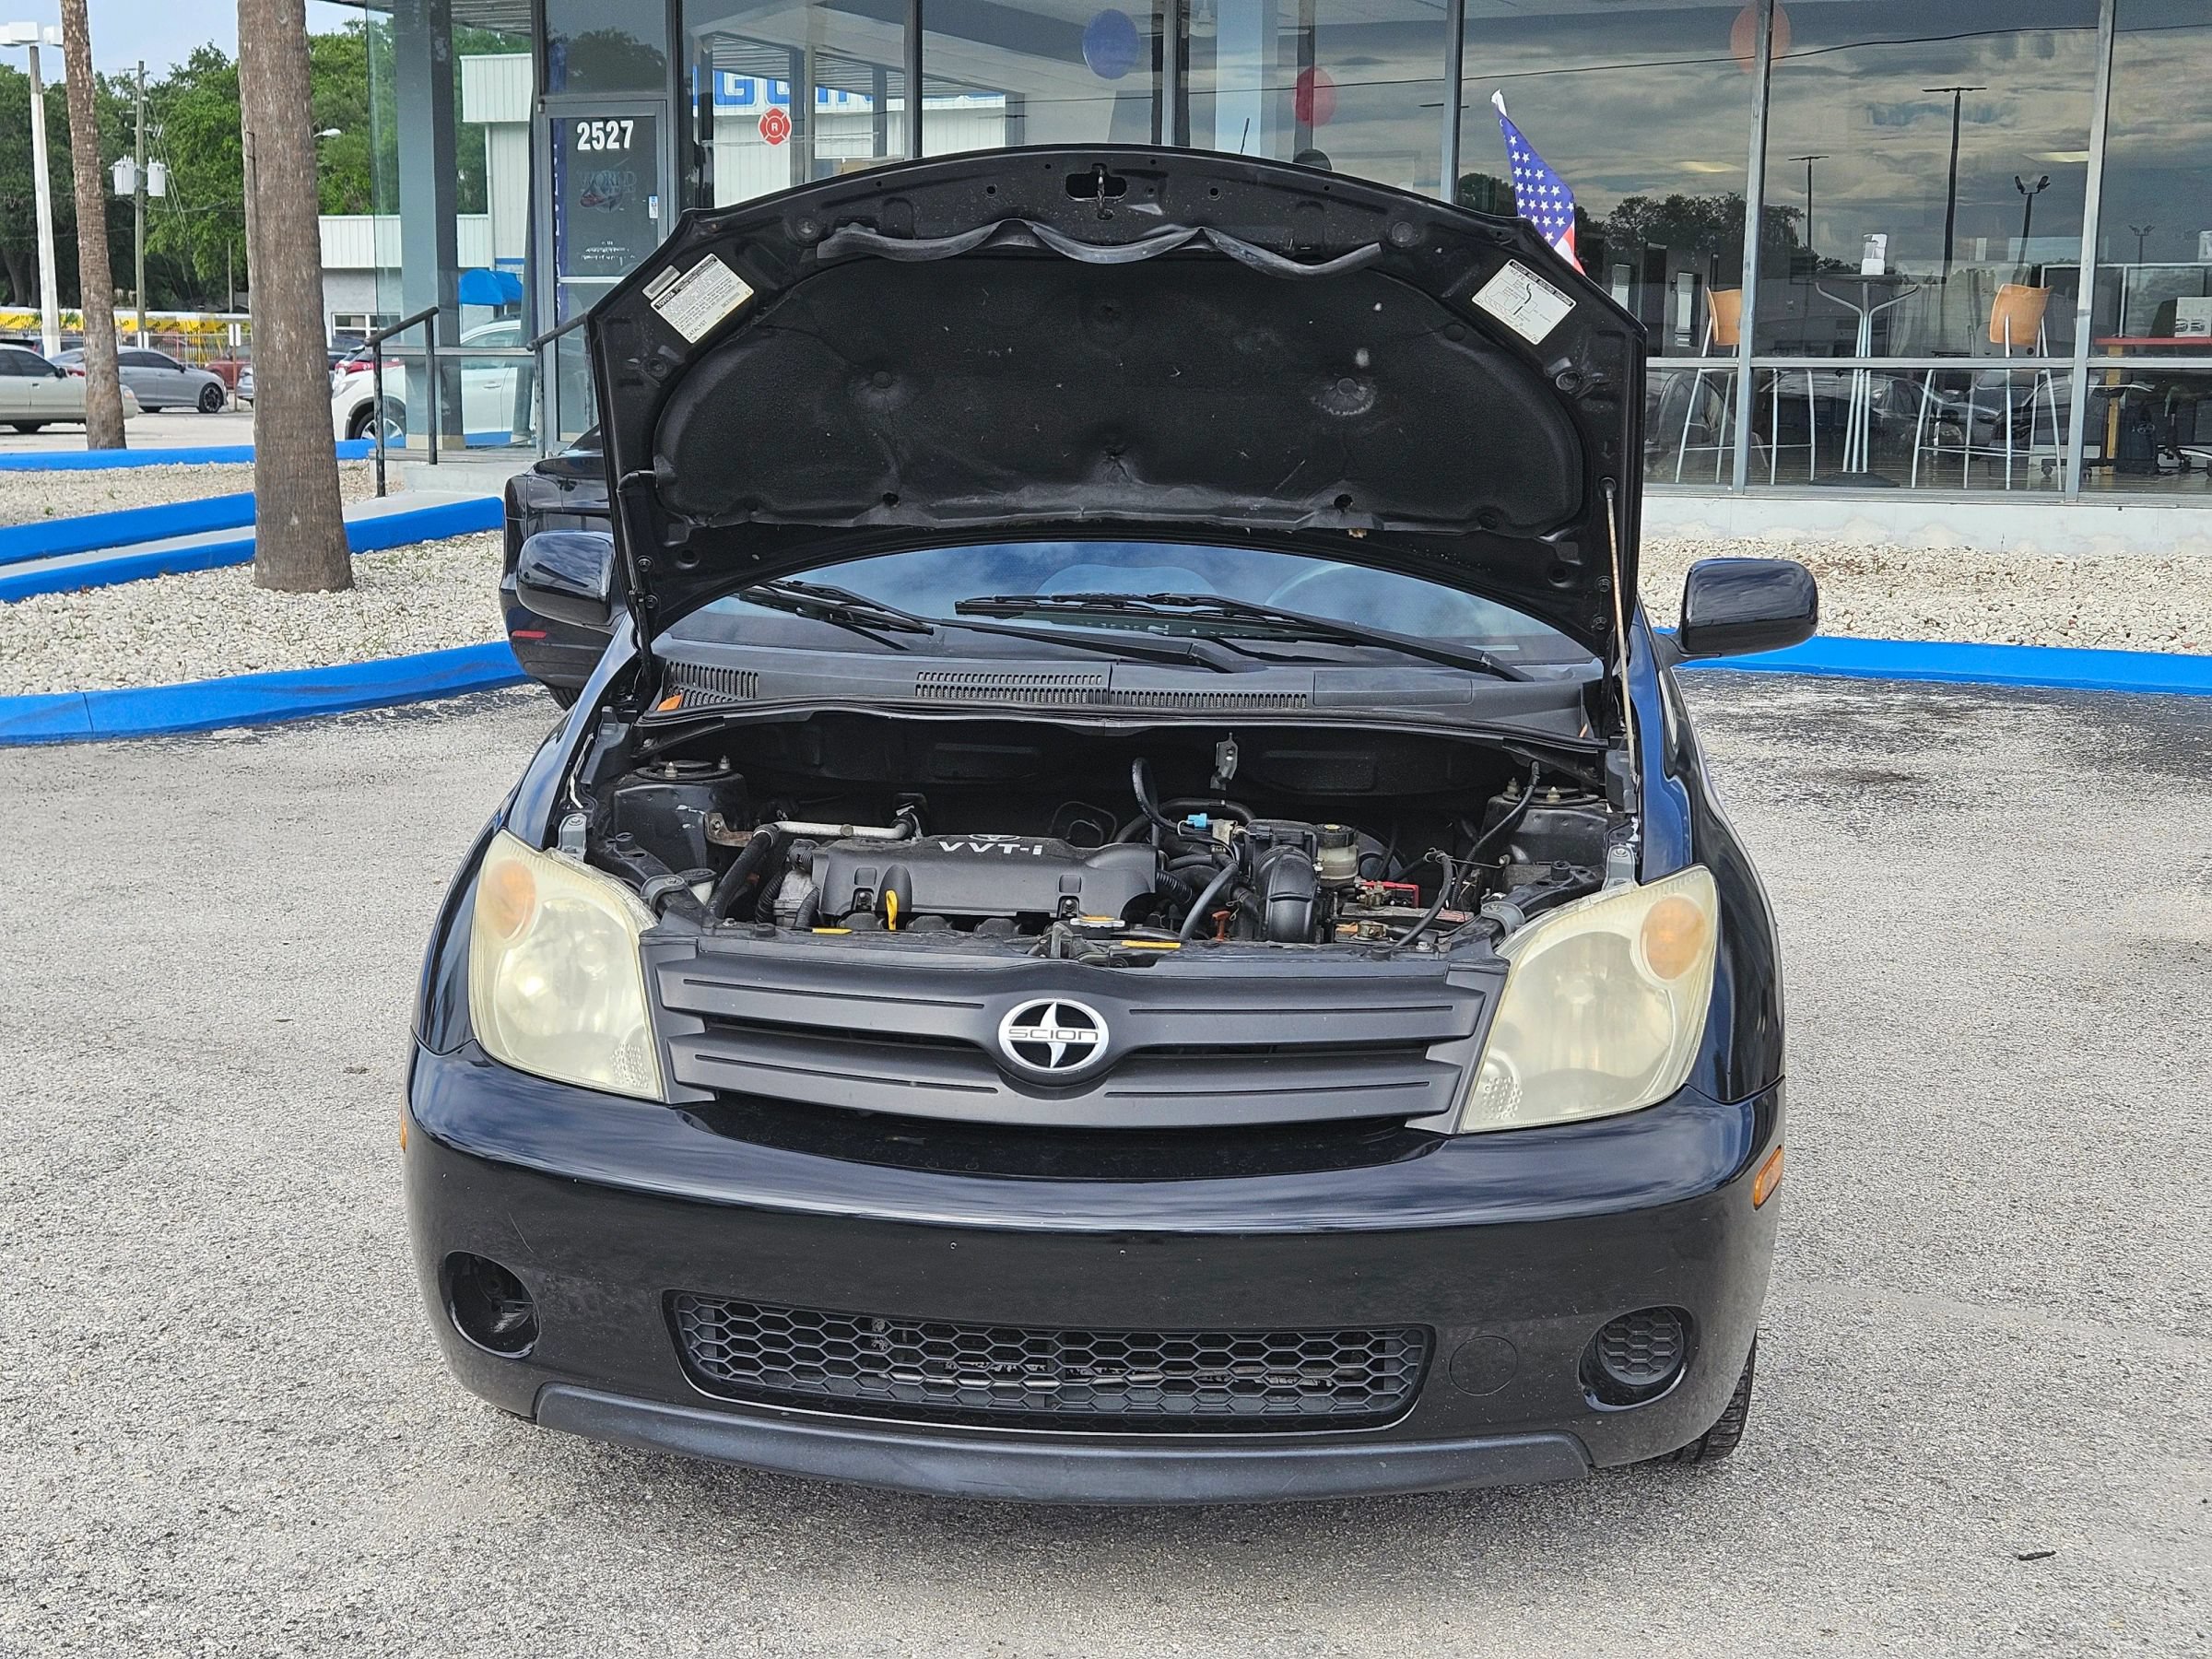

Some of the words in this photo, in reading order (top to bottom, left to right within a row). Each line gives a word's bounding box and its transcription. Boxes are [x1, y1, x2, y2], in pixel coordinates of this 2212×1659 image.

[576, 120, 634, 150] 2527
[771, 122, 779, 132] R
[656, 290, 676, 308] TOYOTA
[686, 319, 708, 339] CATALYST
[938, 841, 1043, 855] VVT-i
[1008, 1028, 1099, 1041] SCION
